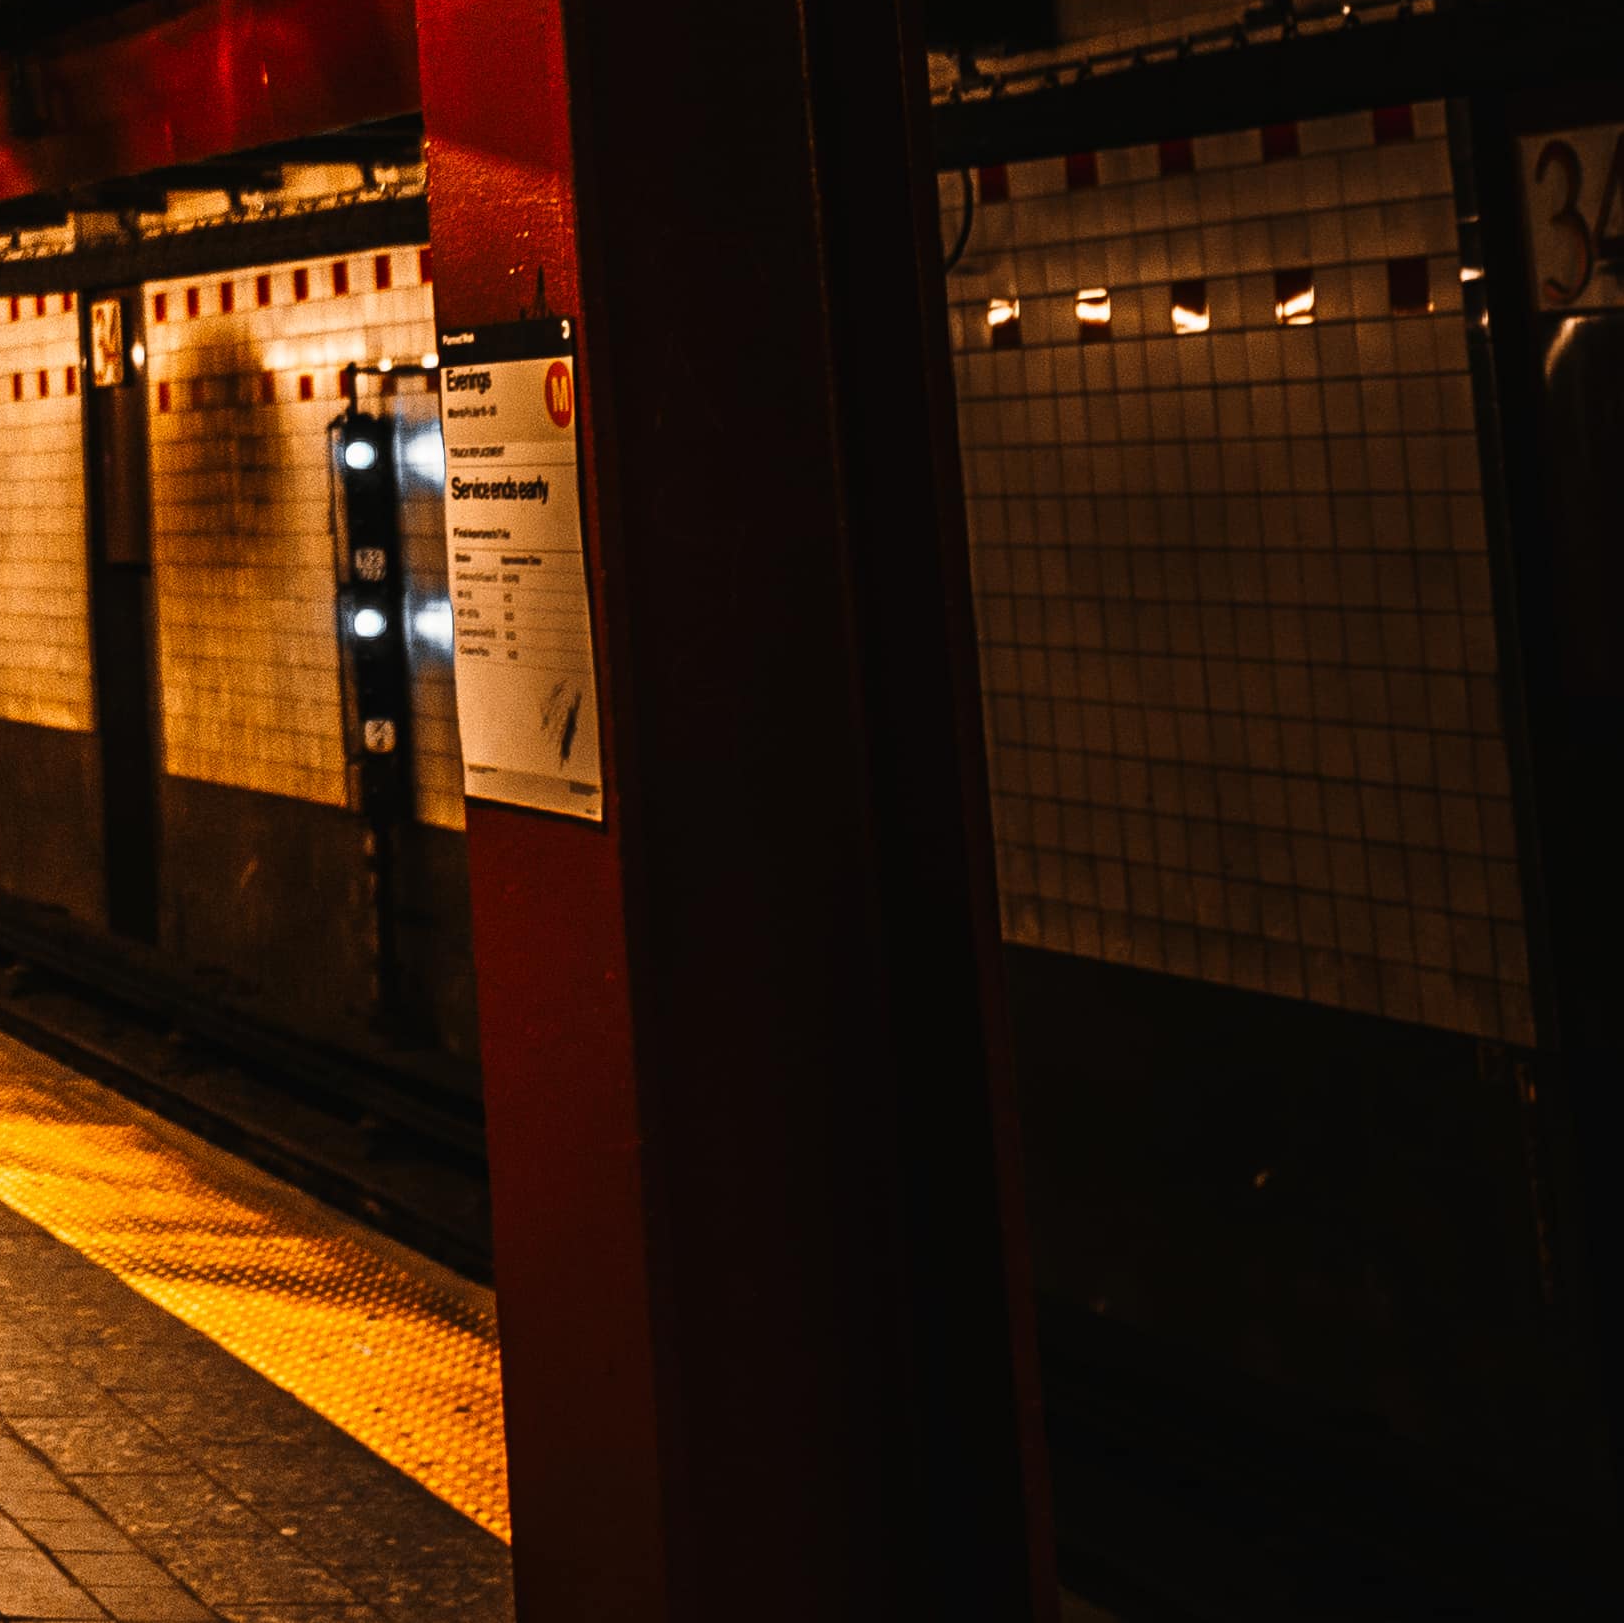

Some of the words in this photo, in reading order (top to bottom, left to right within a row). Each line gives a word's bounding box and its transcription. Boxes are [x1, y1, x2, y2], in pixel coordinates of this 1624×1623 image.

[446, 367, 491, 393] Evenings
[550, 375, 570, 413] M
[451, 476, 490, 500] Service
[491, 476, 517, 500] ends
[518, 475, 549, 504] early
